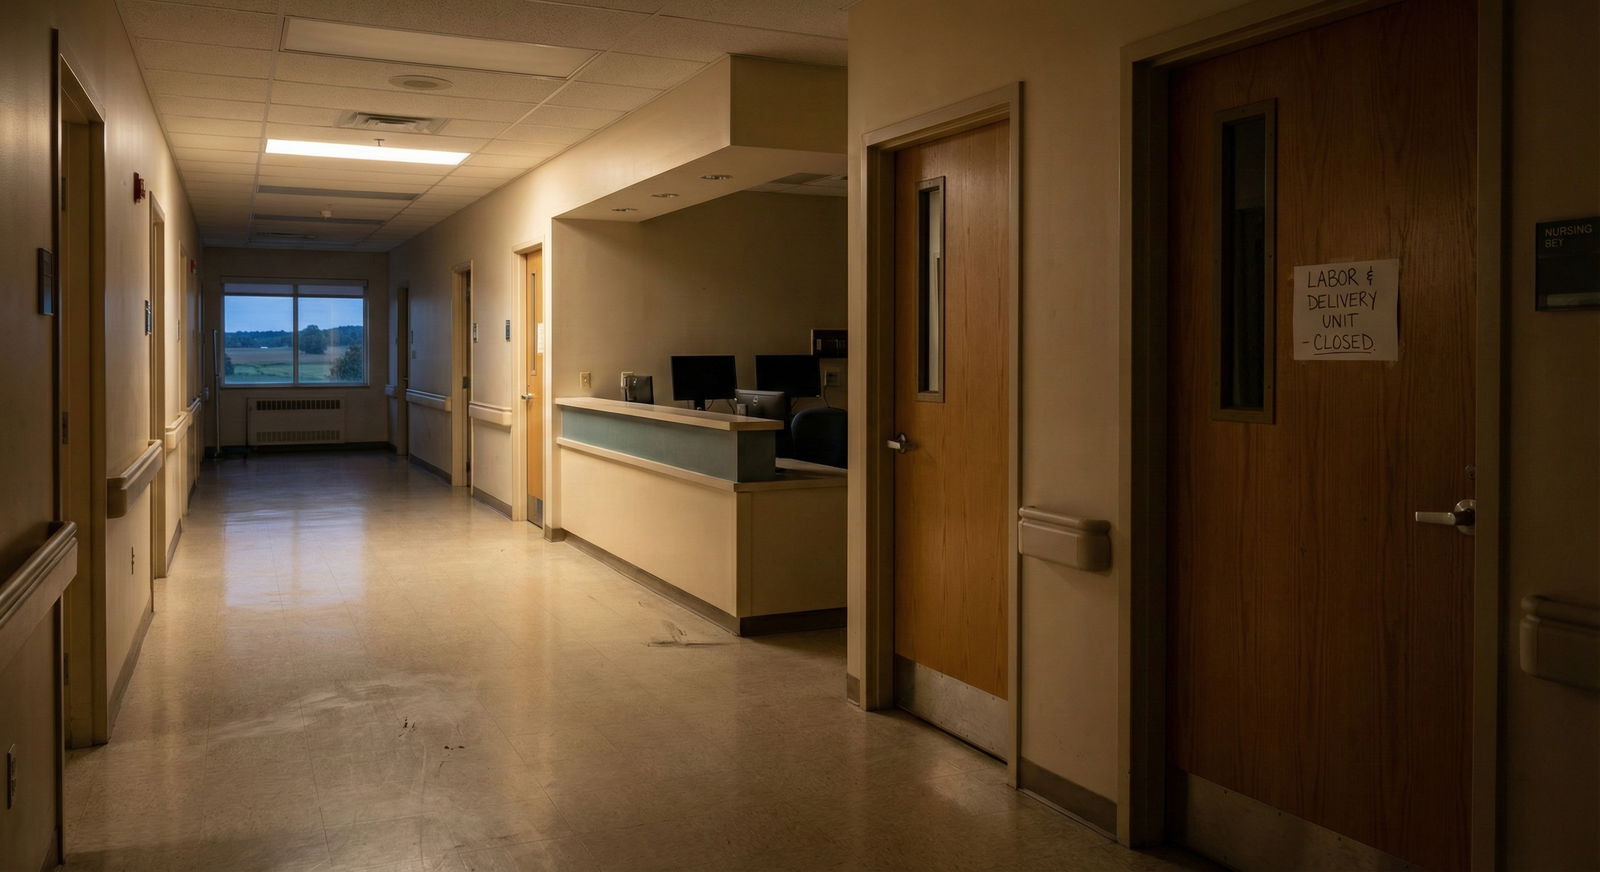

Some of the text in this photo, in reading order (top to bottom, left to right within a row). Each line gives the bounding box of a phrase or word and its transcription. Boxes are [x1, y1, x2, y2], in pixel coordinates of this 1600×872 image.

[1545, 224, 1593, 237] NURSING
[1307, 265, 1374, 288] LABOR &
[1307, 291, 1377, 310] DELIVERY
[1322, 312, 1359, 328] UNIT
